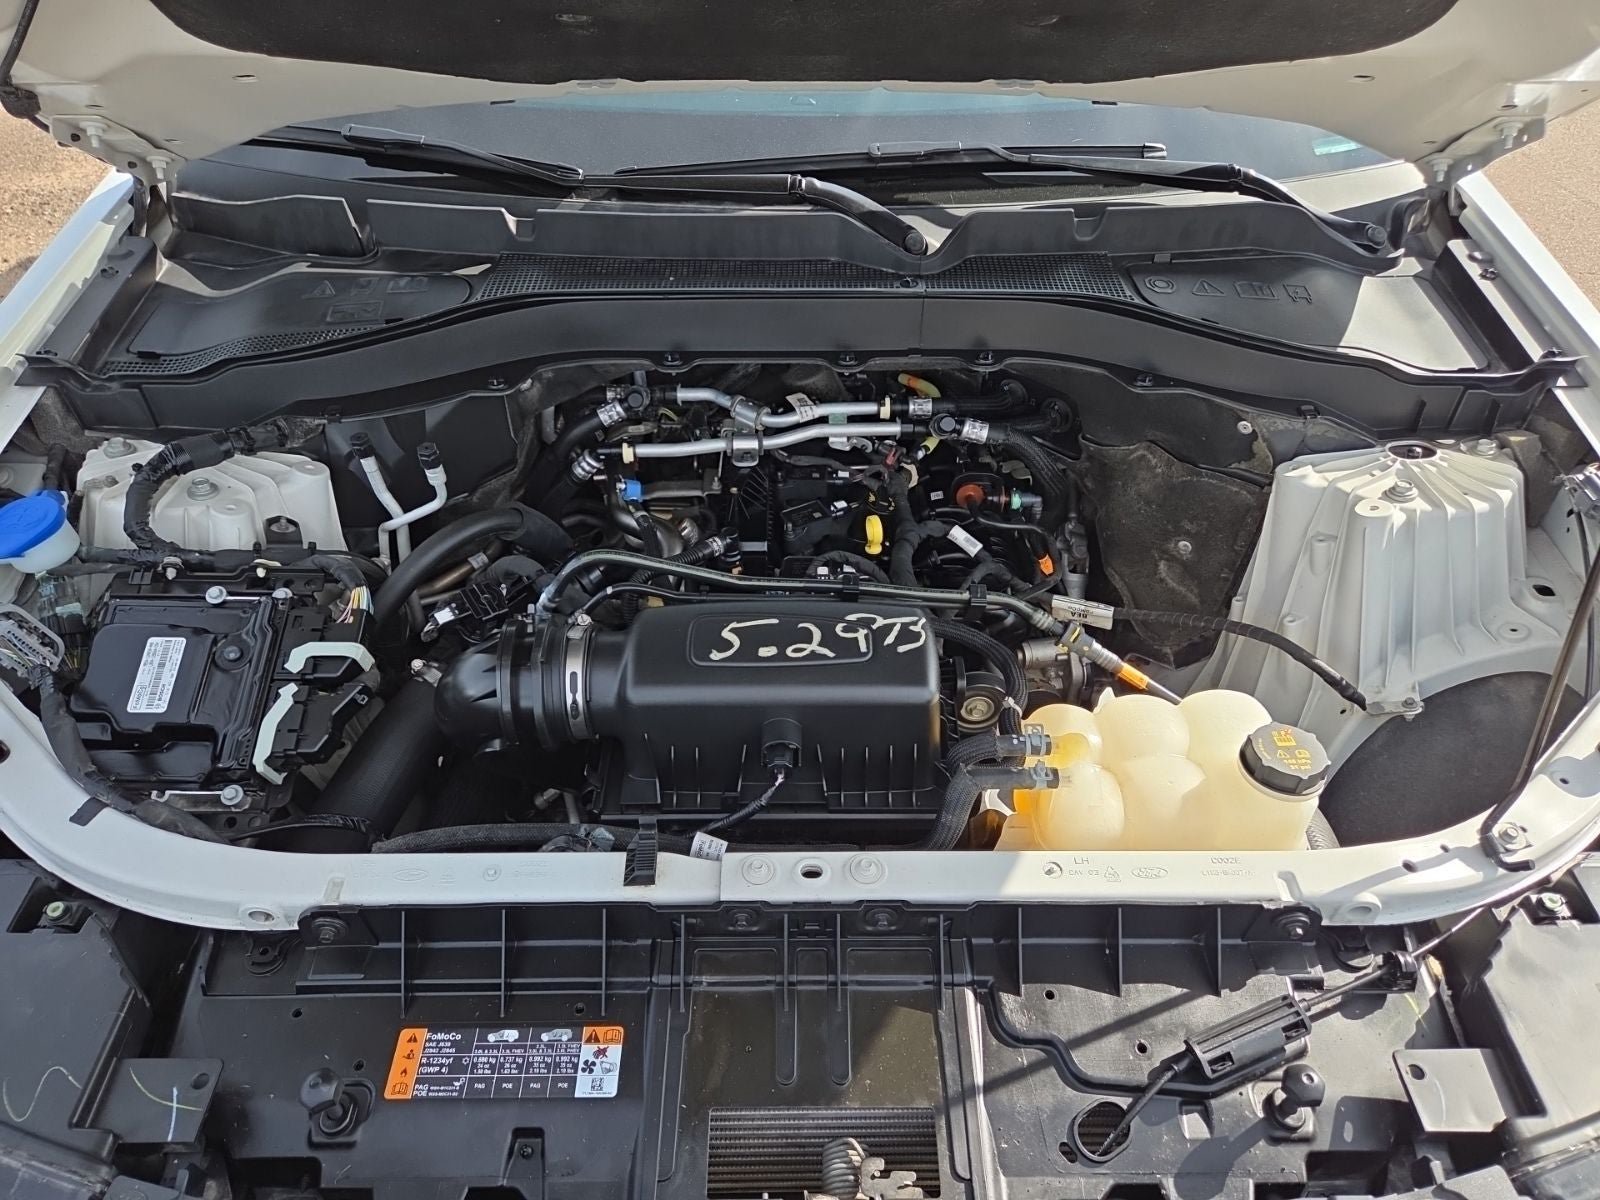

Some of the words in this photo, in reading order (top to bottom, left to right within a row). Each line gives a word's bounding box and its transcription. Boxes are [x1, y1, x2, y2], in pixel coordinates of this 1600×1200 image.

[157, 684, 166, 702] BOSCH
[1073, 856, 1089, 865] LH
[426, 1032, 461, 1041] FoMoCo
[421, 1057, 453, 1065] R-1234yf
[418, 1066, 440, 1075] (GWP
[440, 1066, 449, 1074] 4)
